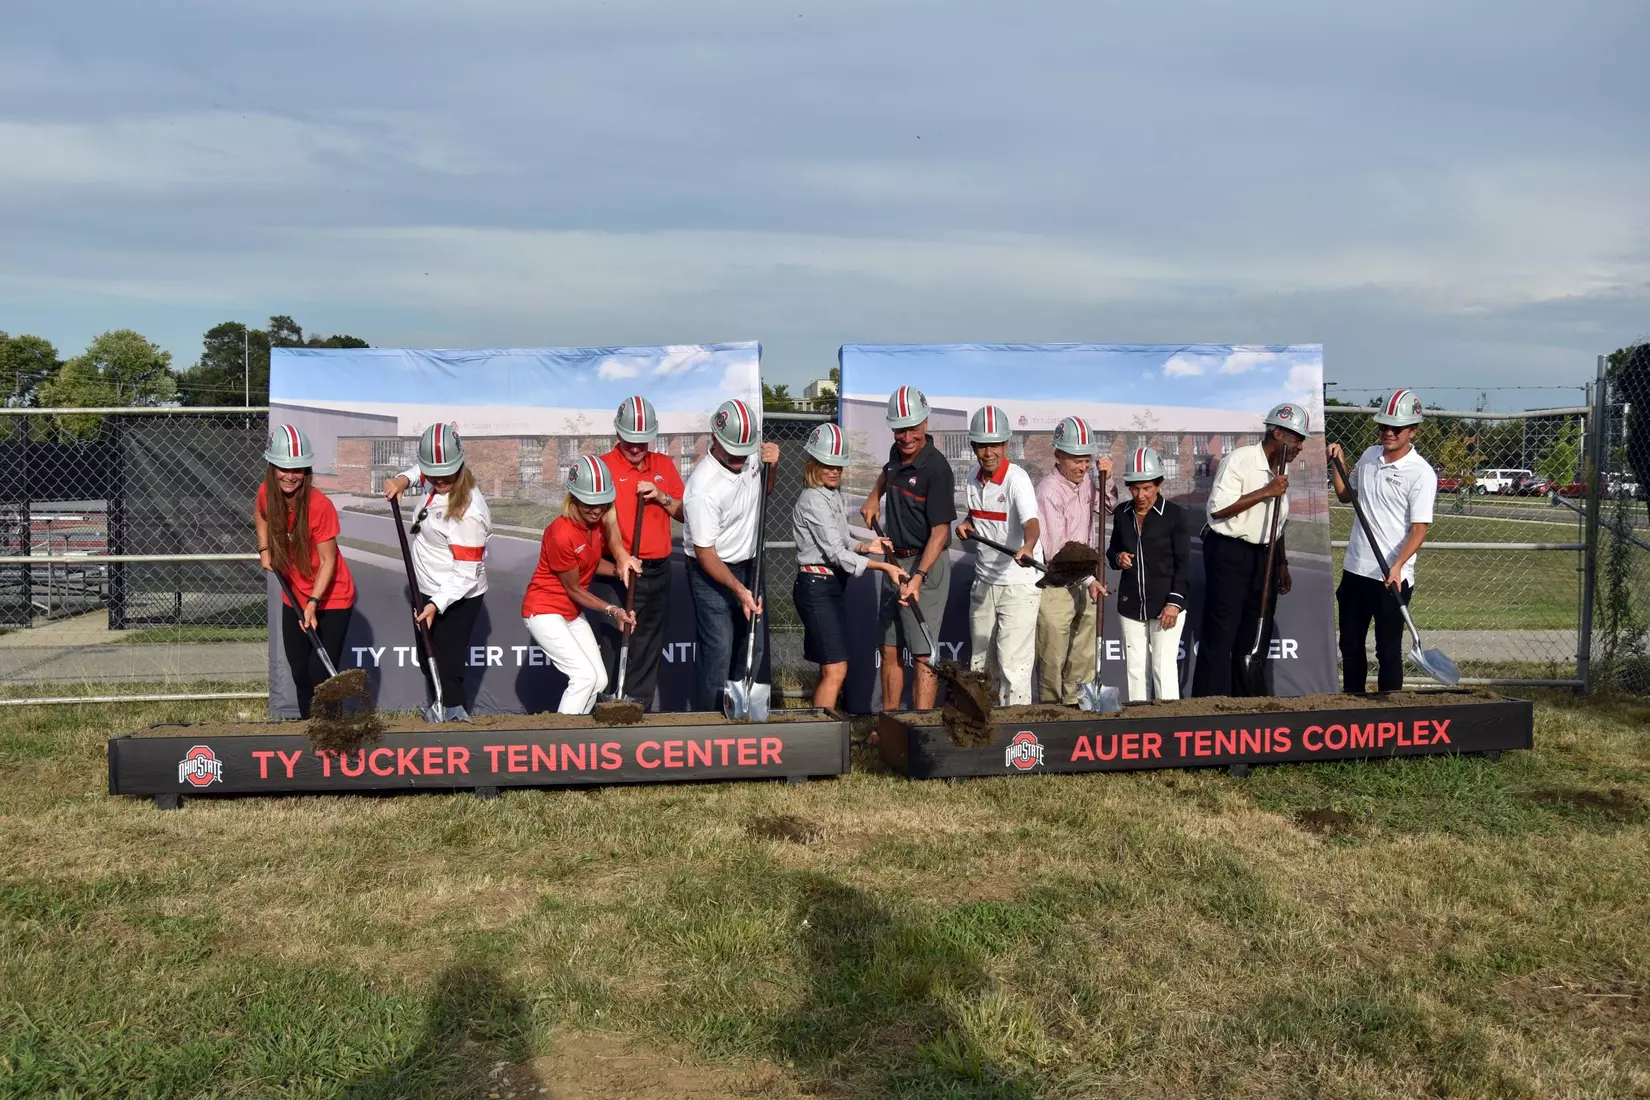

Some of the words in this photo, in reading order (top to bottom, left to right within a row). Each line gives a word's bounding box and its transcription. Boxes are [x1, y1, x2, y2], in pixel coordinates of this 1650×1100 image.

[351, 646, 387, 668] TY
[393, 645, 504, 668] TUER
[252, 750, 302, 779] TY
[315, 746, 470, 778] TUCKER
[483, 743, 622, 774] TENNIS
[635, 737, 783, 768] CENTER
[1070, 732, 1163, 762] AUER
[1174, 727, 1292, 757] TENNIS
[1302, 719, 1451, 751] COMPLEX
